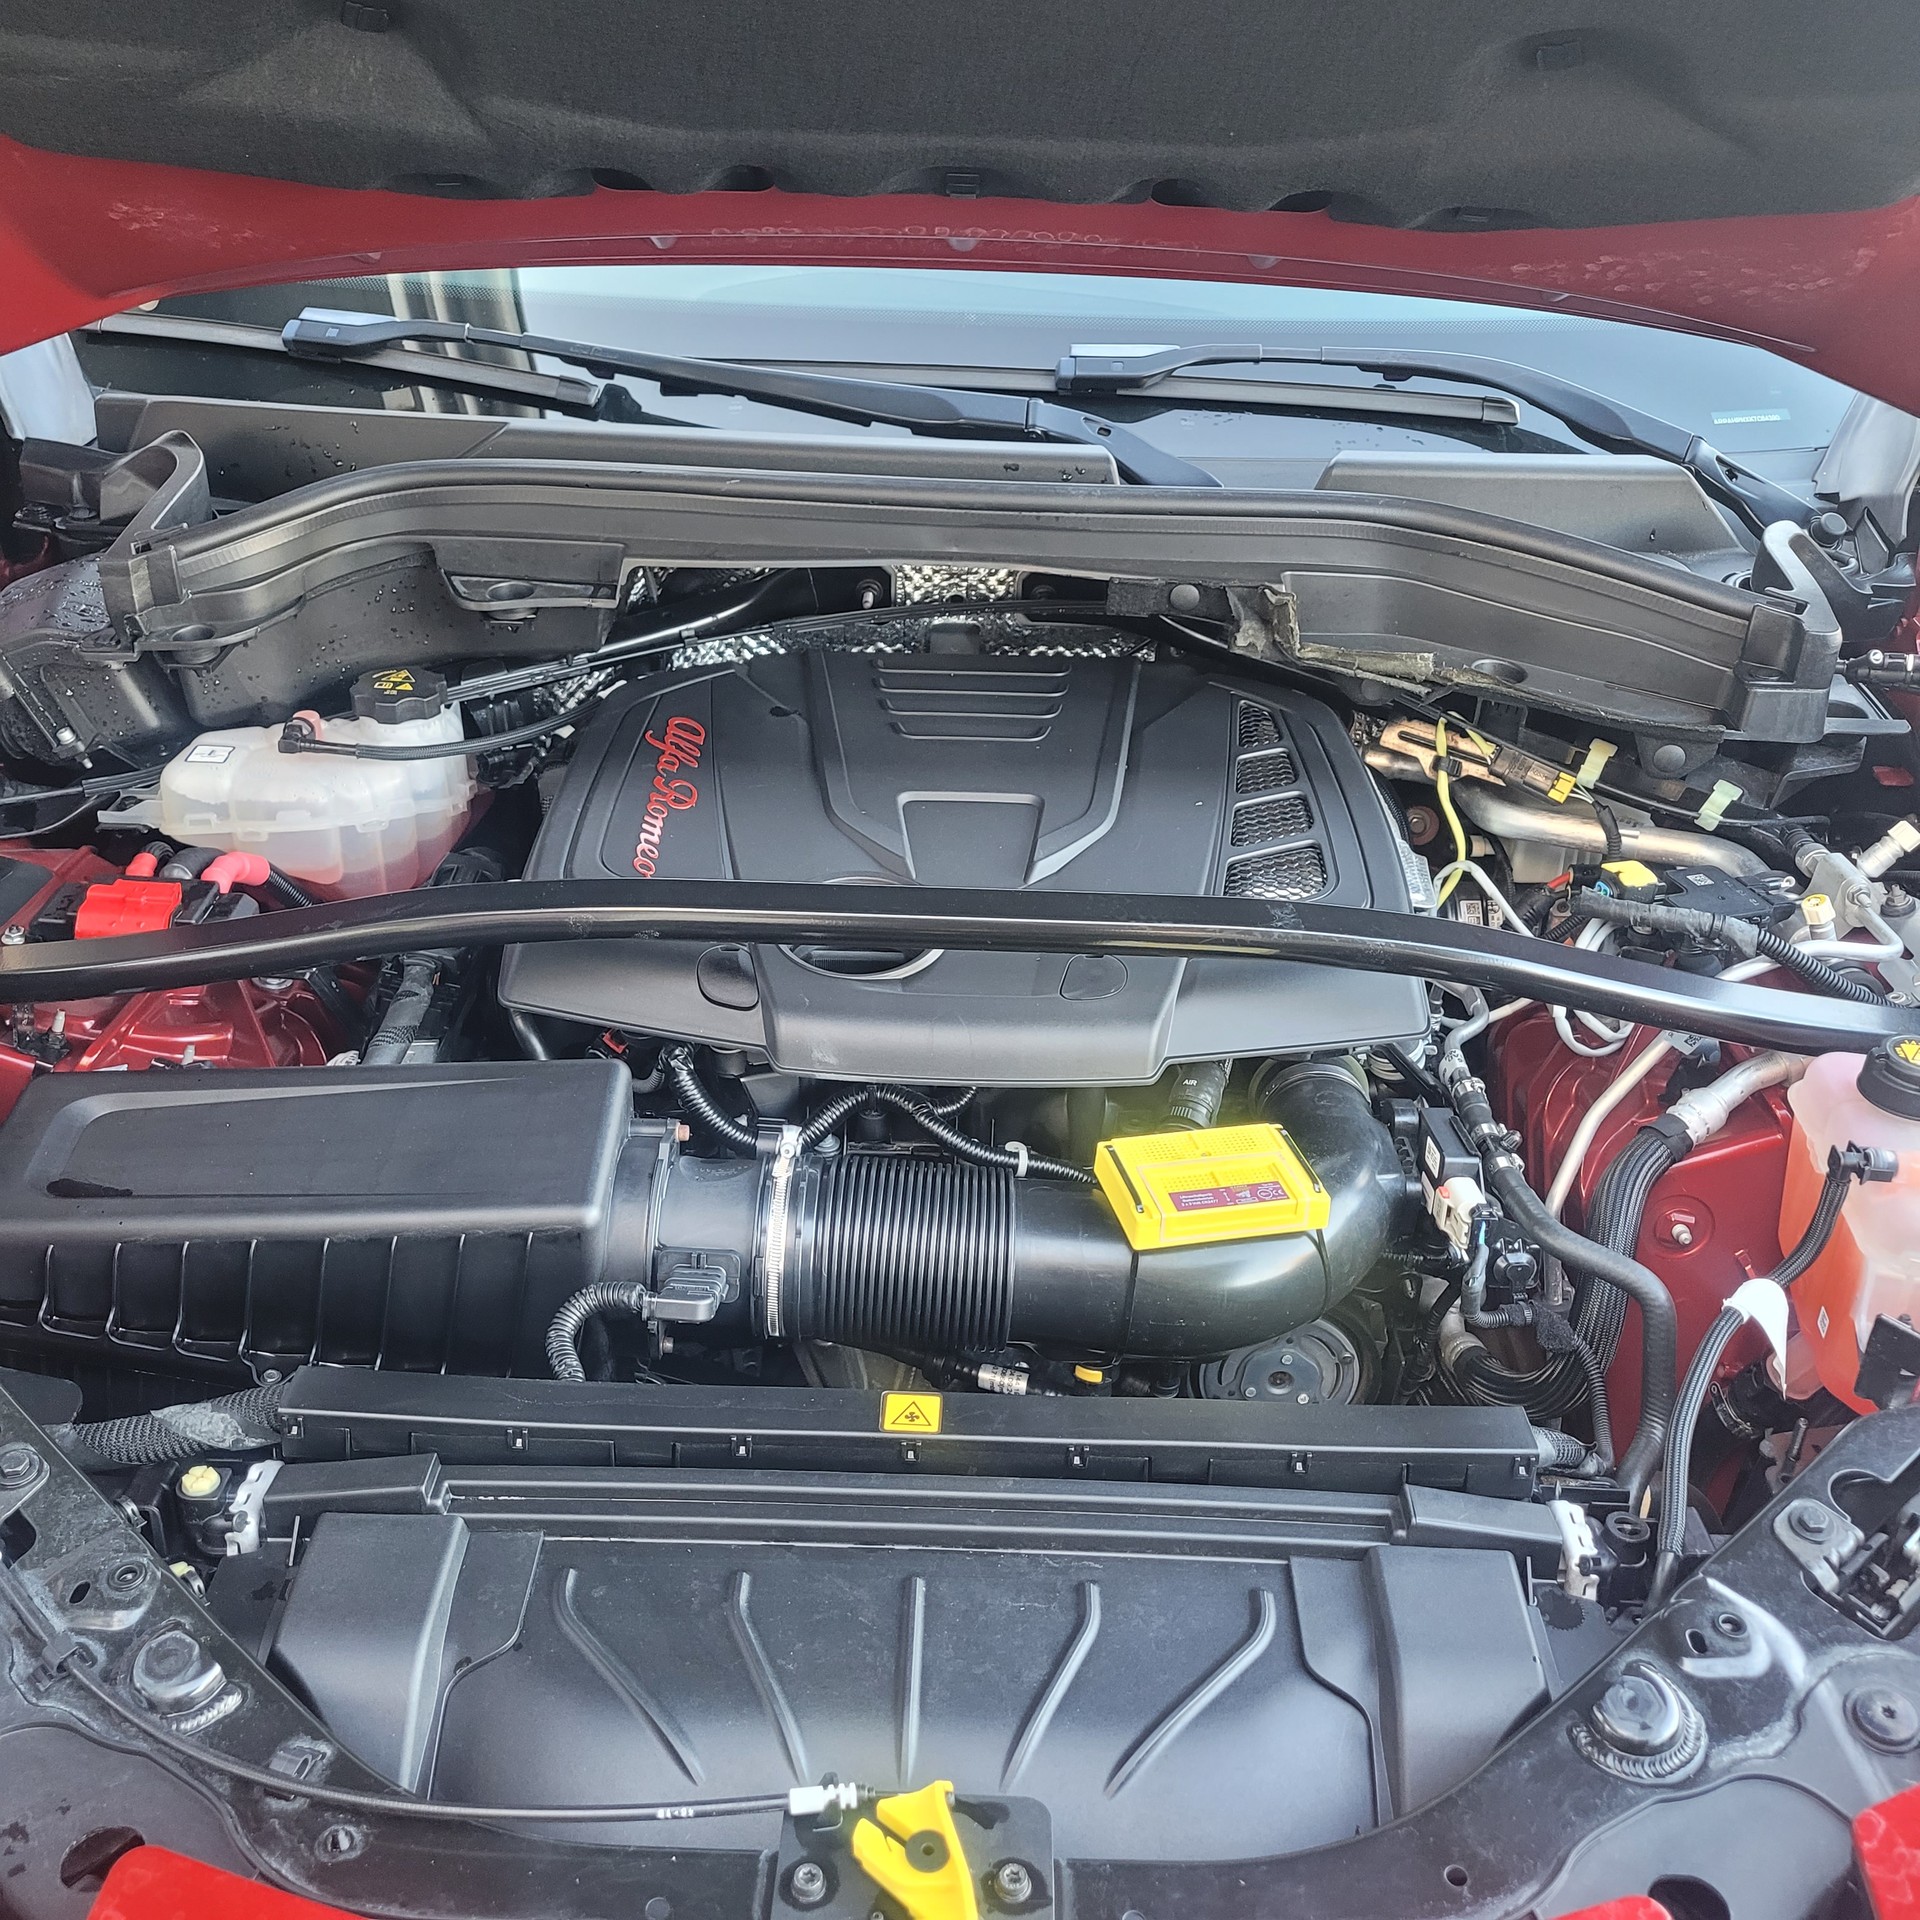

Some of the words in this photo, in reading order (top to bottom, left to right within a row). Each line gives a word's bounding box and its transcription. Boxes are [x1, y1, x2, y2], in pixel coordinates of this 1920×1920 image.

[644, 716, 706, 777] Alfa
[633, 775, 699, 878] Romeo
[1182, 1078, 1198, 1086] AIR
